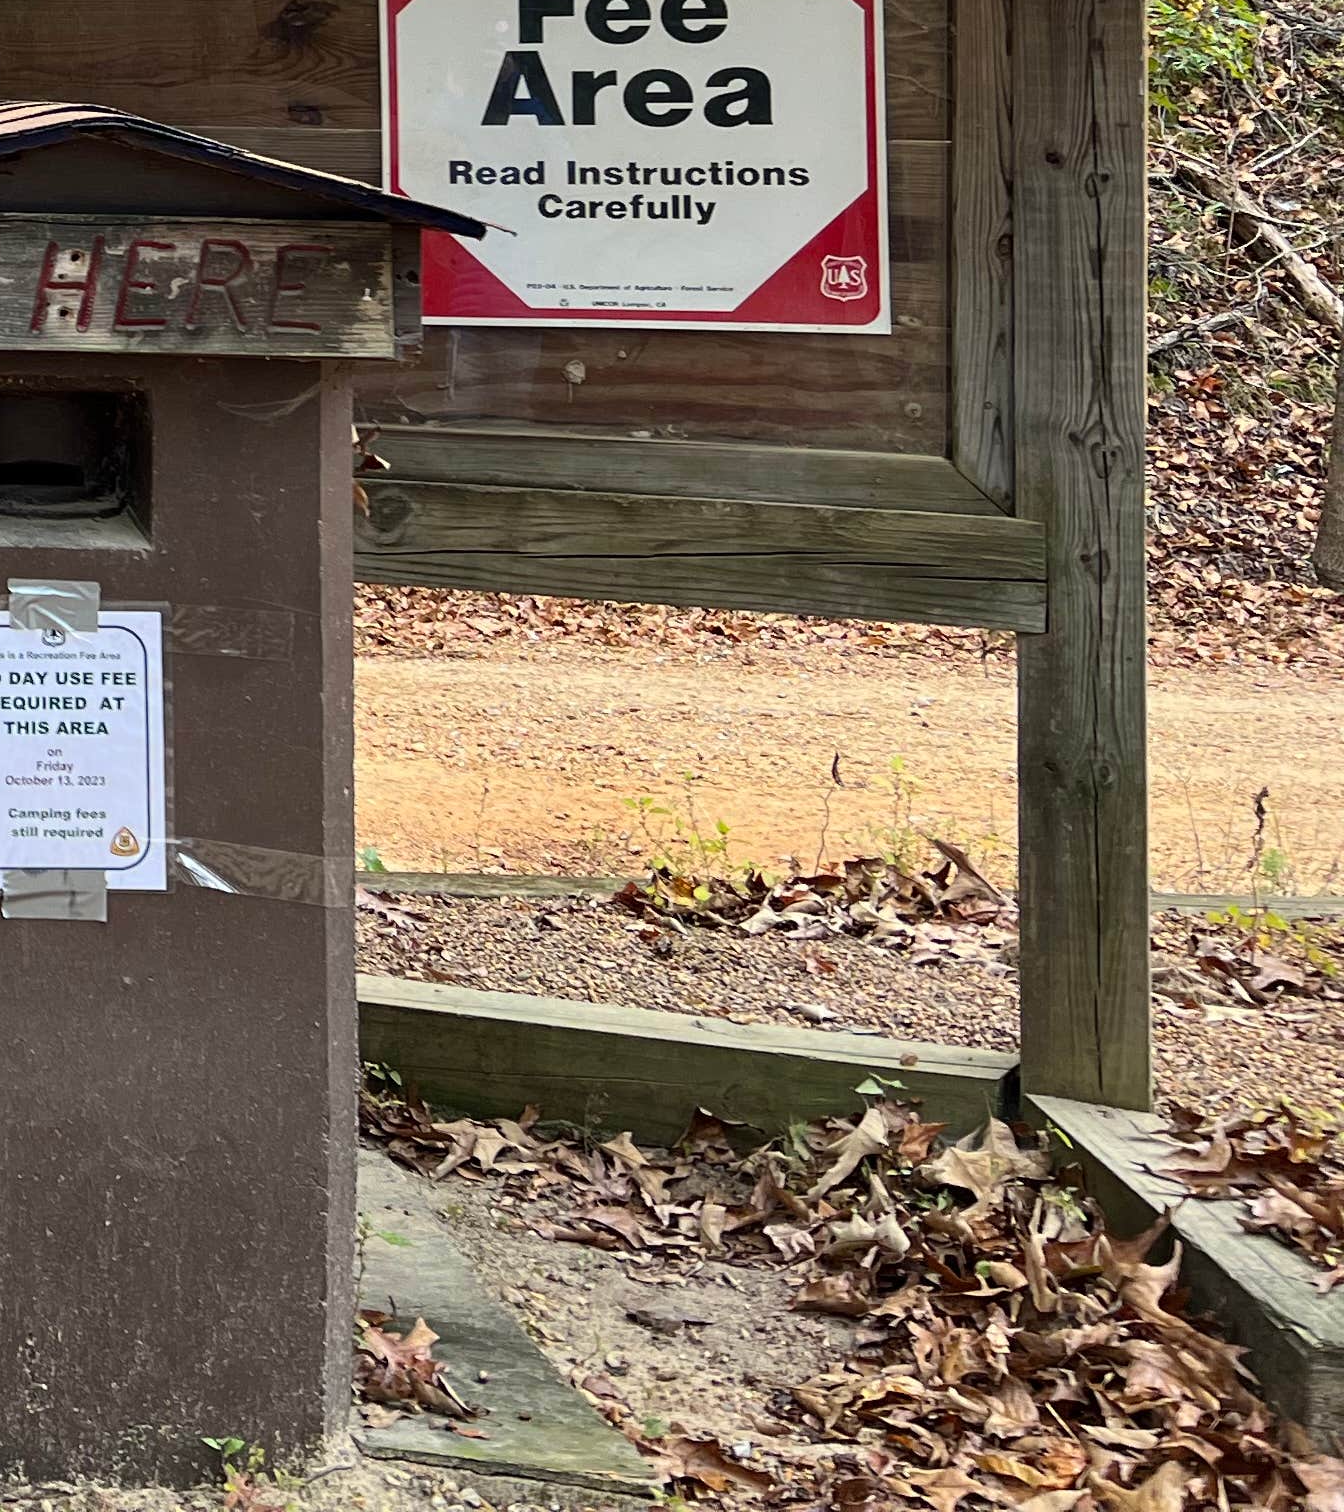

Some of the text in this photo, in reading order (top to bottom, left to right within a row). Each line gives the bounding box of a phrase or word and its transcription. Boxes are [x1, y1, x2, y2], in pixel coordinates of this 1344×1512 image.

[481, 50, 773, 128] Area
[449, 160, 811, 187] Read Instructions
[537, 193, 716, 225] Carefully
[29, 234, 336, 336] HERE
[7, 651, 16, 660] is
[26, 651, 78, 660] Recreation
[80, 651, 97, 660] Fee
[99, 651, 121, 660] Area
[9, 672, 48, 685] DAY
[56, 672, 94, 685] USE
[101, 672, 137, 685] FEE
[100, 697, 125, 710] AT
[4, 721, 109, 735] THIS AREA
[47, 749, 63, 757] on
[36, 761, 74, 773] Friday
[5, 775, 106, 786] October 13, 2023
[8, 808, 107, 820] Camping fees
[11, 827, 104, 840] still required
